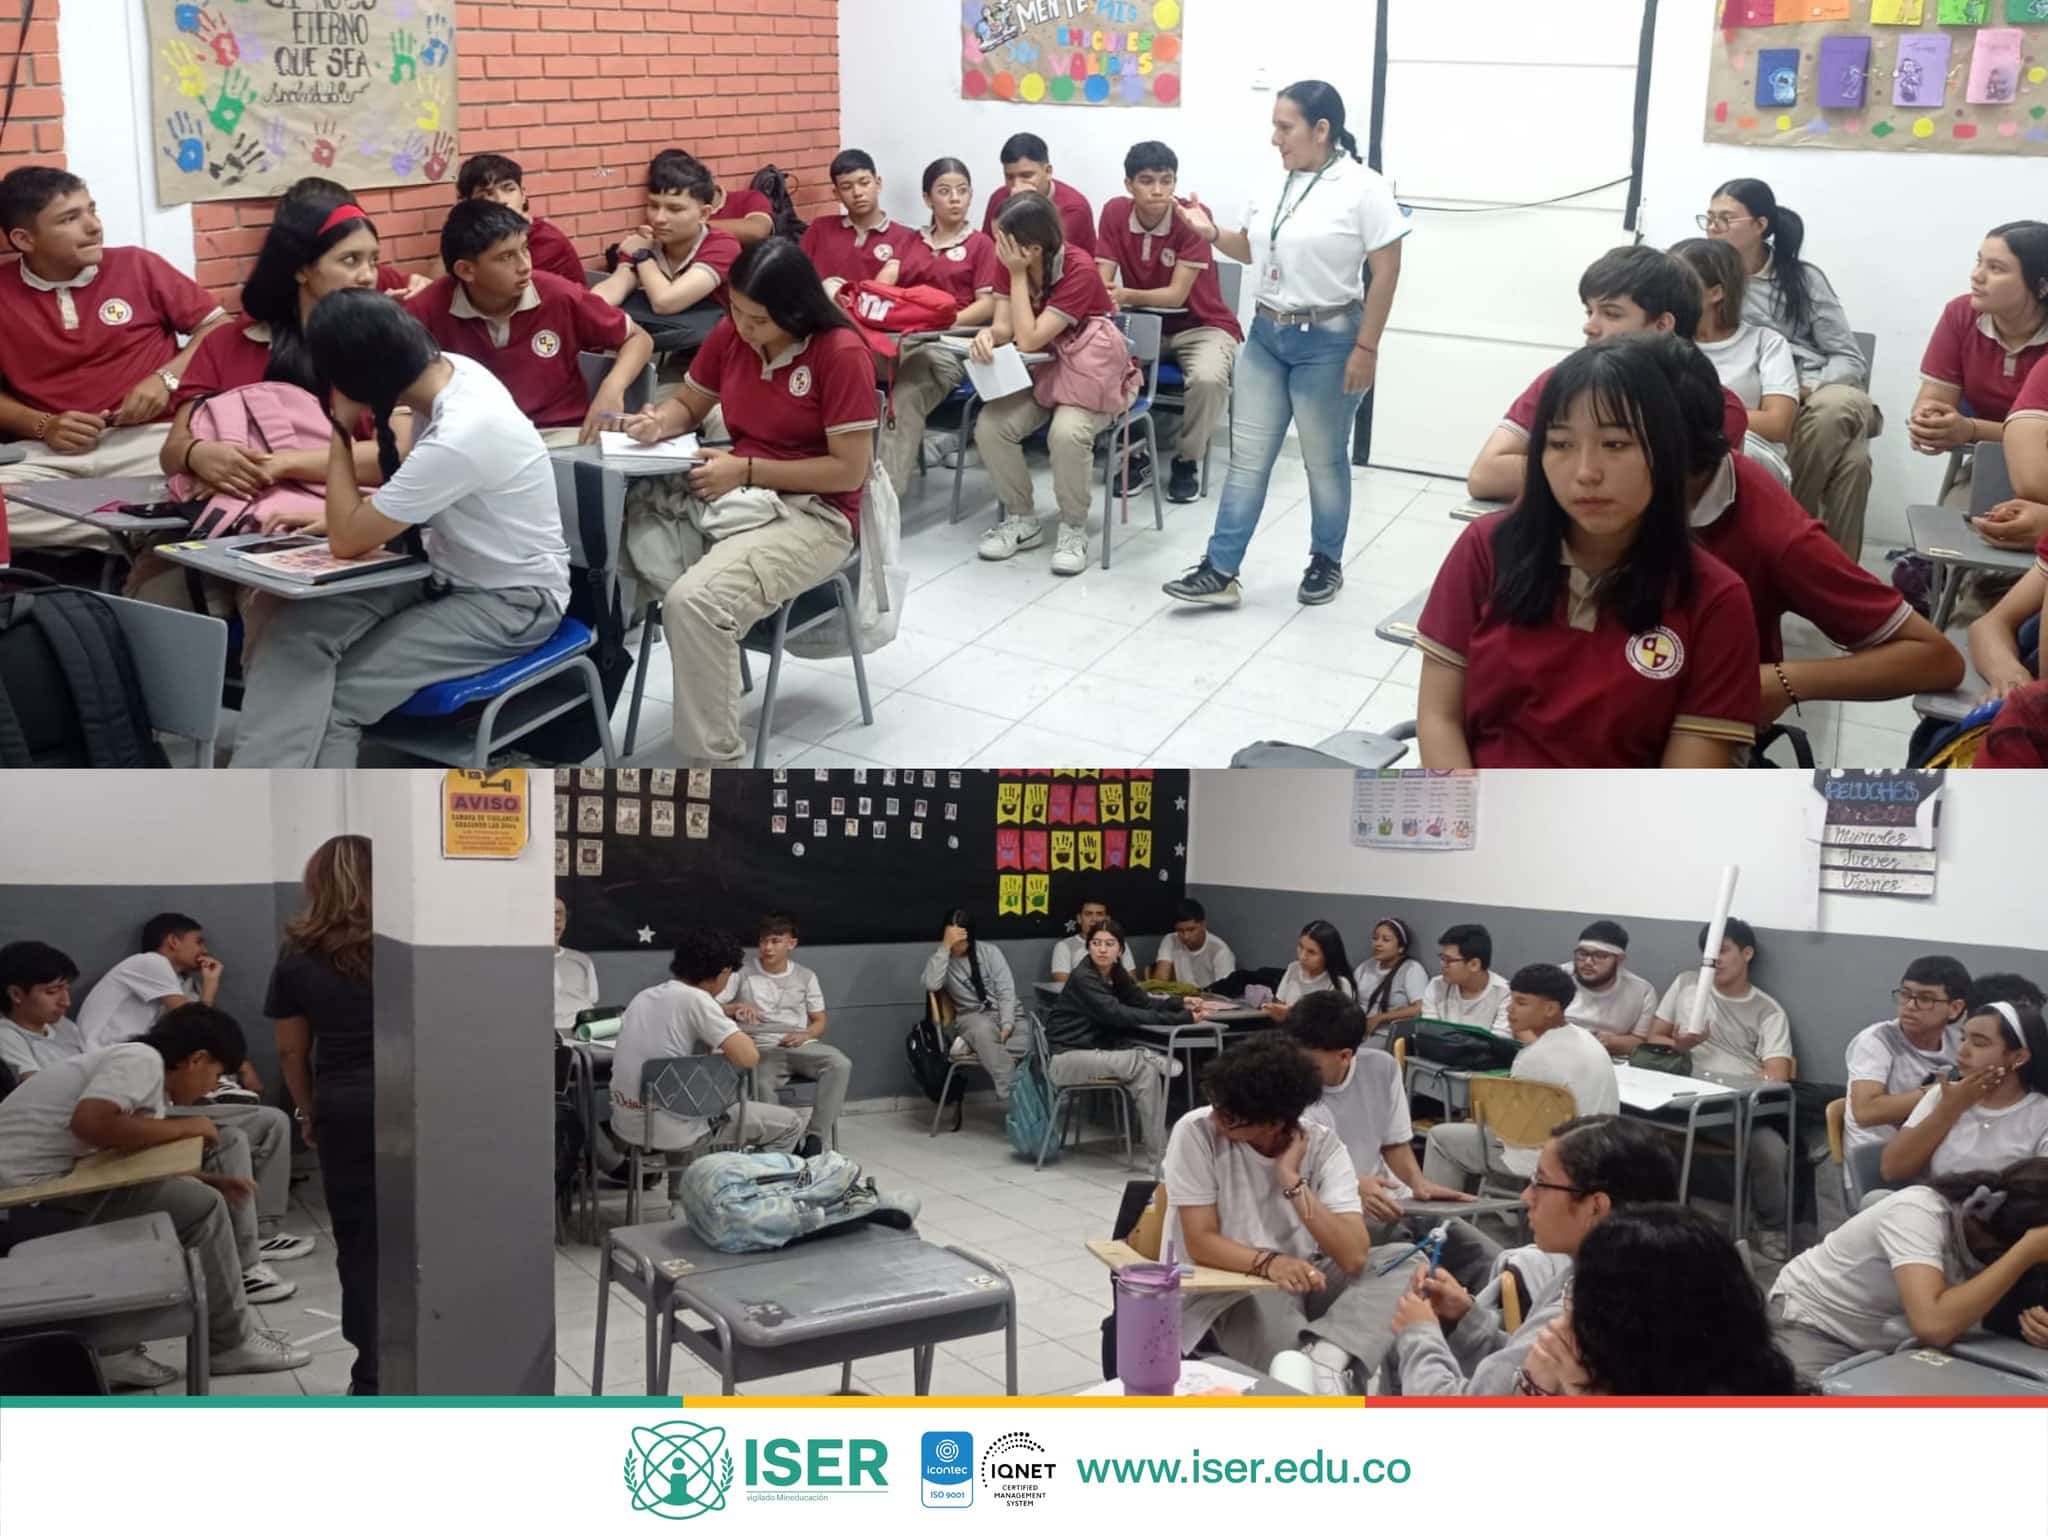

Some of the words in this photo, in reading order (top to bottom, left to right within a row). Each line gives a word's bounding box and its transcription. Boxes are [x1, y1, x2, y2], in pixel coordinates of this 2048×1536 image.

[292, 11, 368, 45] ETERNO
[274, 46, 318, 77] QUE
[326, 47, 372, 78] SEA
[454, 796, 517, 810] AVISO
